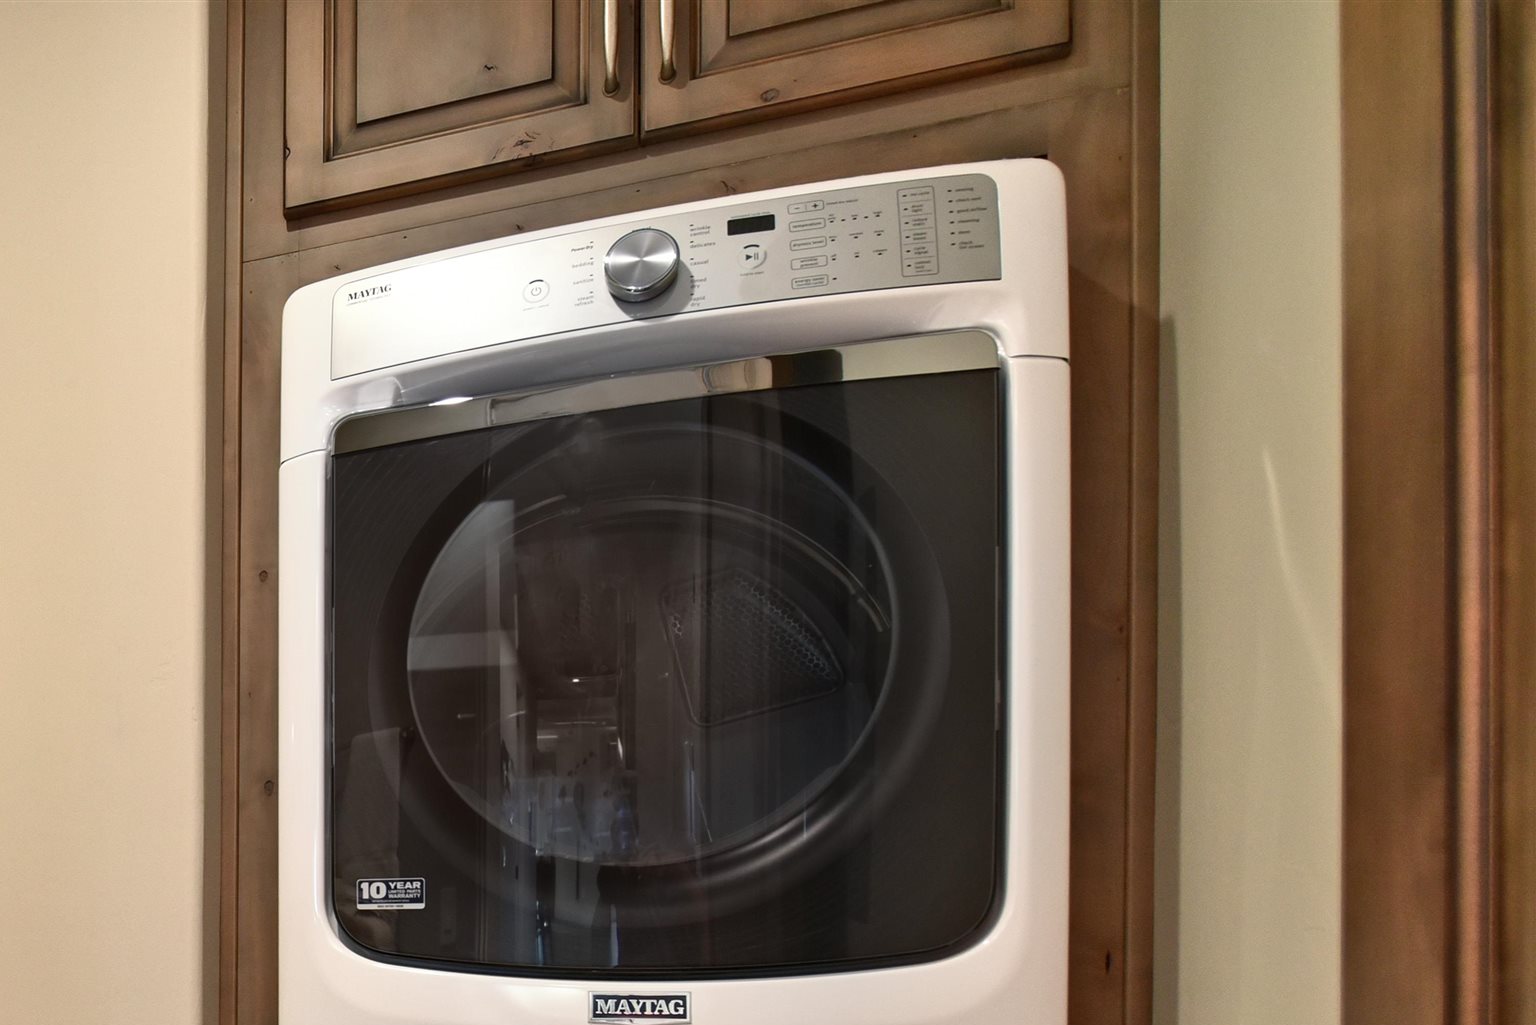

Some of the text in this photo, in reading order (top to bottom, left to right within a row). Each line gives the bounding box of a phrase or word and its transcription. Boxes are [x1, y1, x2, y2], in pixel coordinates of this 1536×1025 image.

[347, 284, 392, 302] MAYTAG
[360, 881, 421, 899] 10 YEAR
[595, 998, 685, 1015] MAYTAG
